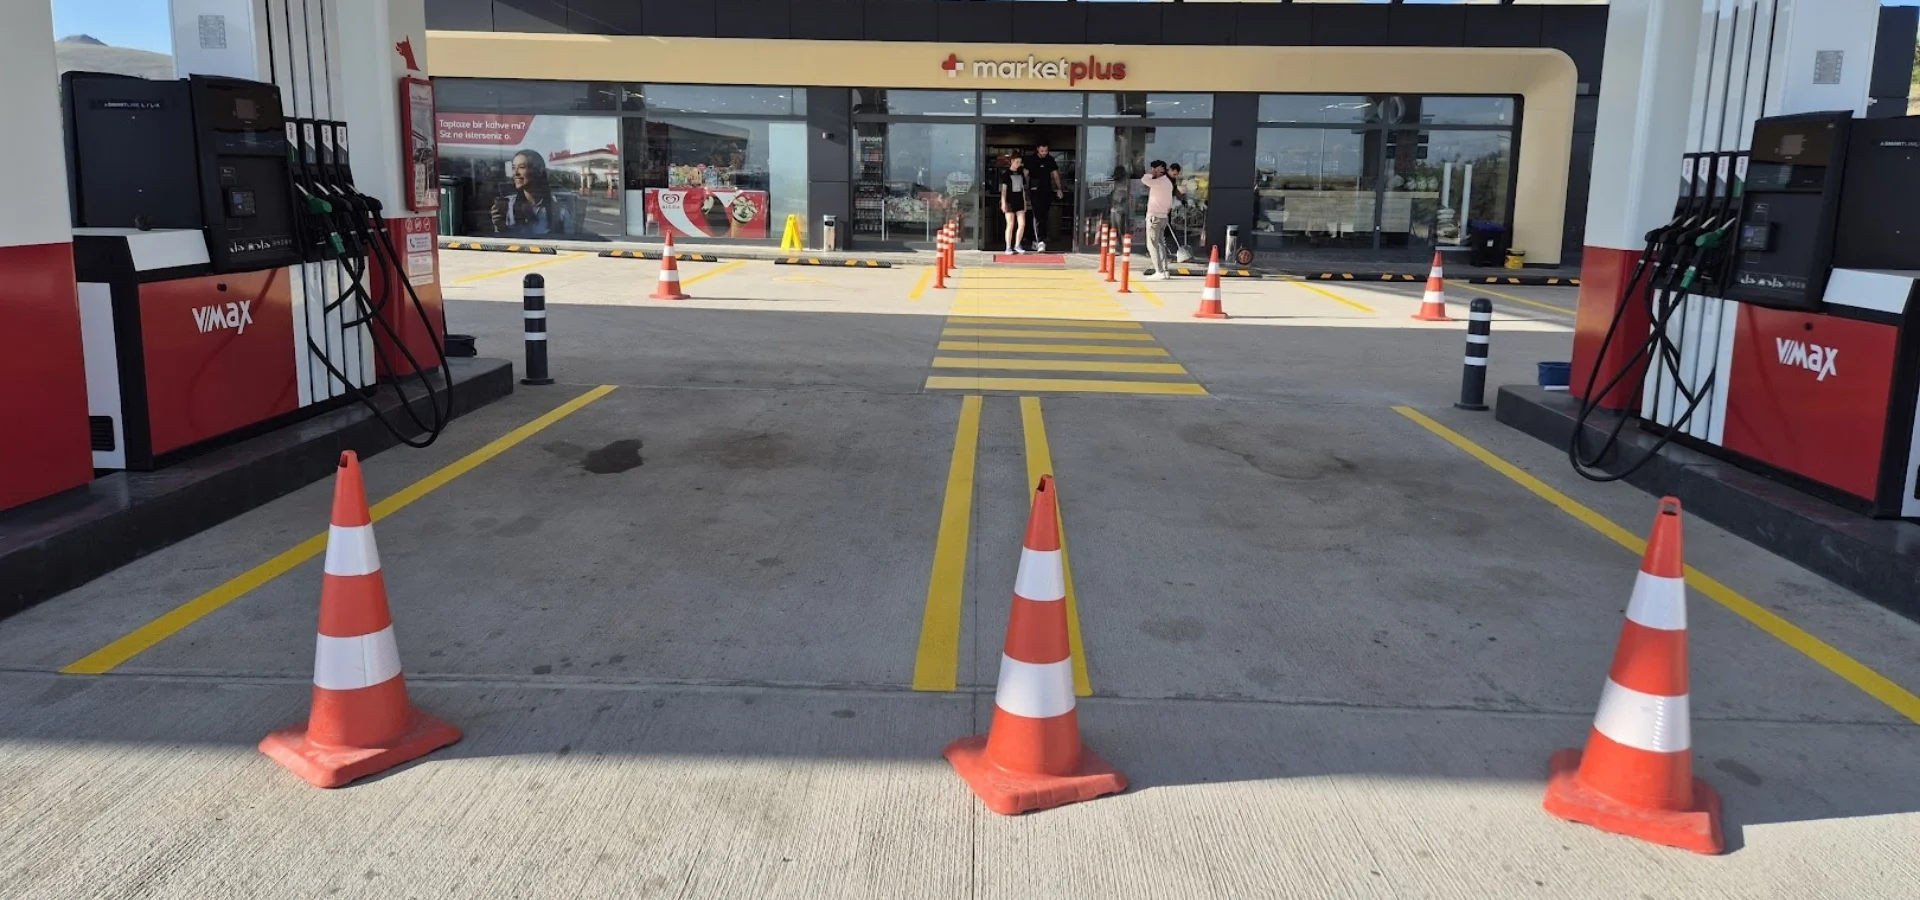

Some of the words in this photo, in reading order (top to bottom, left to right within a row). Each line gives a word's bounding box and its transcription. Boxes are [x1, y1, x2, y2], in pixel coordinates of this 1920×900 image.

[973, 54, 1127, 87] marketplus
[439, 119, 471, 129] Taptaze
[472, 120, 483, 129] bir
[485, 121, 509, 129] kahve
[511, 121, 526, 130] mi?
[439, 130, 451, 138] Siz
[465, 131, 502, 140] isterseniz
